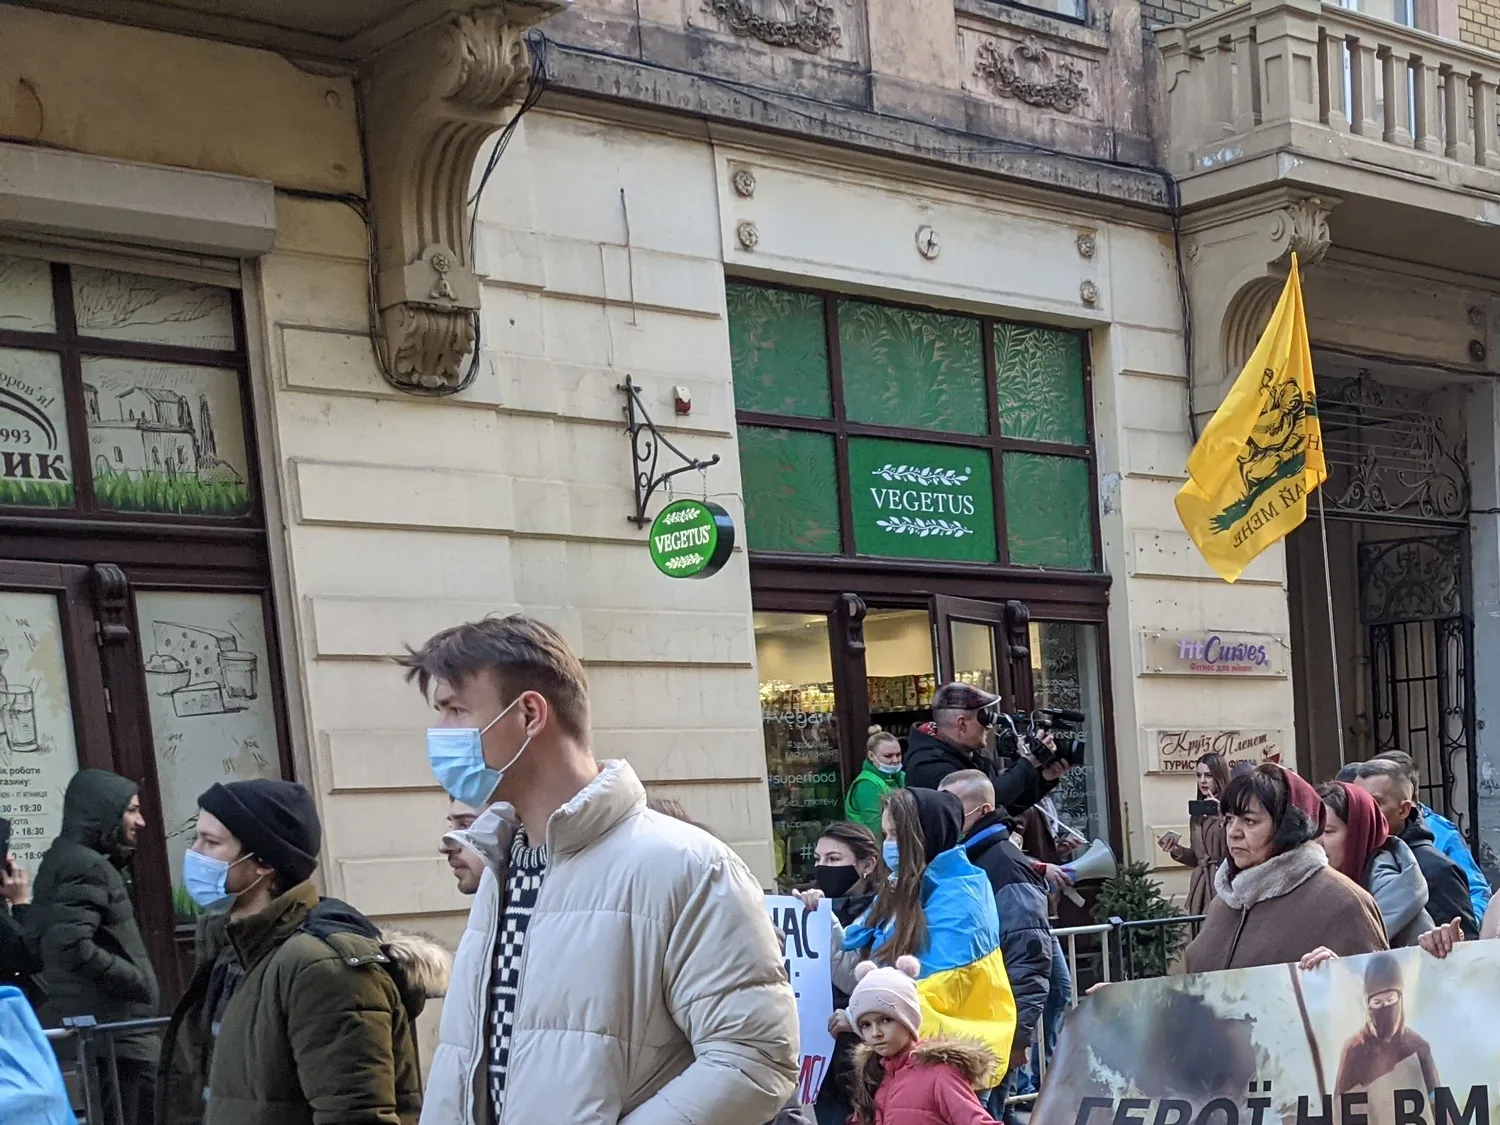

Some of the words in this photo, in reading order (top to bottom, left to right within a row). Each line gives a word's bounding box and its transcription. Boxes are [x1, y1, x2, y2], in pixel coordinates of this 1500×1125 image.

[869, 487, 975, 515] VEGETUS
[654, 525, 711, 554] VEGETUS
[10, 766, 41, 775] роботи
[20, 804, 42, 812] 19:30
[22, 827, 44, 836] 18:30
